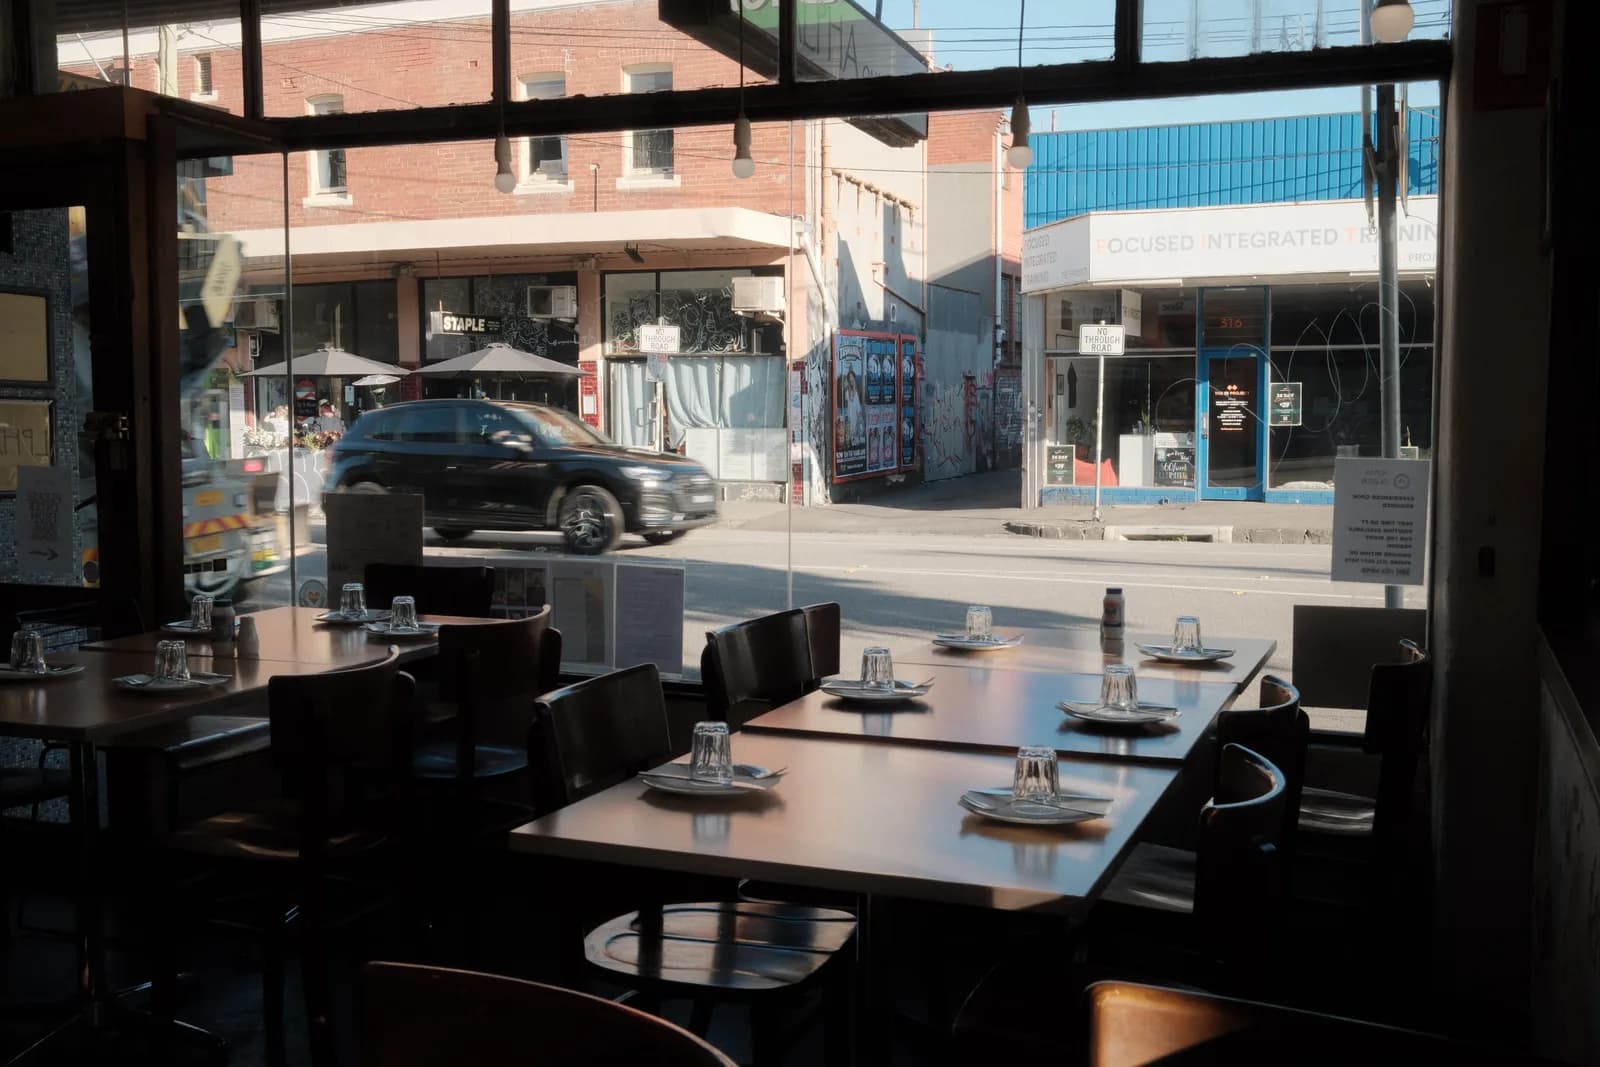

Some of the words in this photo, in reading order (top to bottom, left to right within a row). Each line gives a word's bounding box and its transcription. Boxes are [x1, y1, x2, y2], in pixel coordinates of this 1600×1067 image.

[1096, 235, 1194, 256] FOCUSED
[1202, 228, 1338, 254] INTEGRATED
[1344, 224, 1437, 247] TRNIN
[443, 316, 486, 332] STAPLE
[655, 328, 665, 336] NO
[1097, 328, 1108, 336] NO
[1084, 336, 1120, 344] THROUGH
[1091, 344, 1112, 352] ROAD
